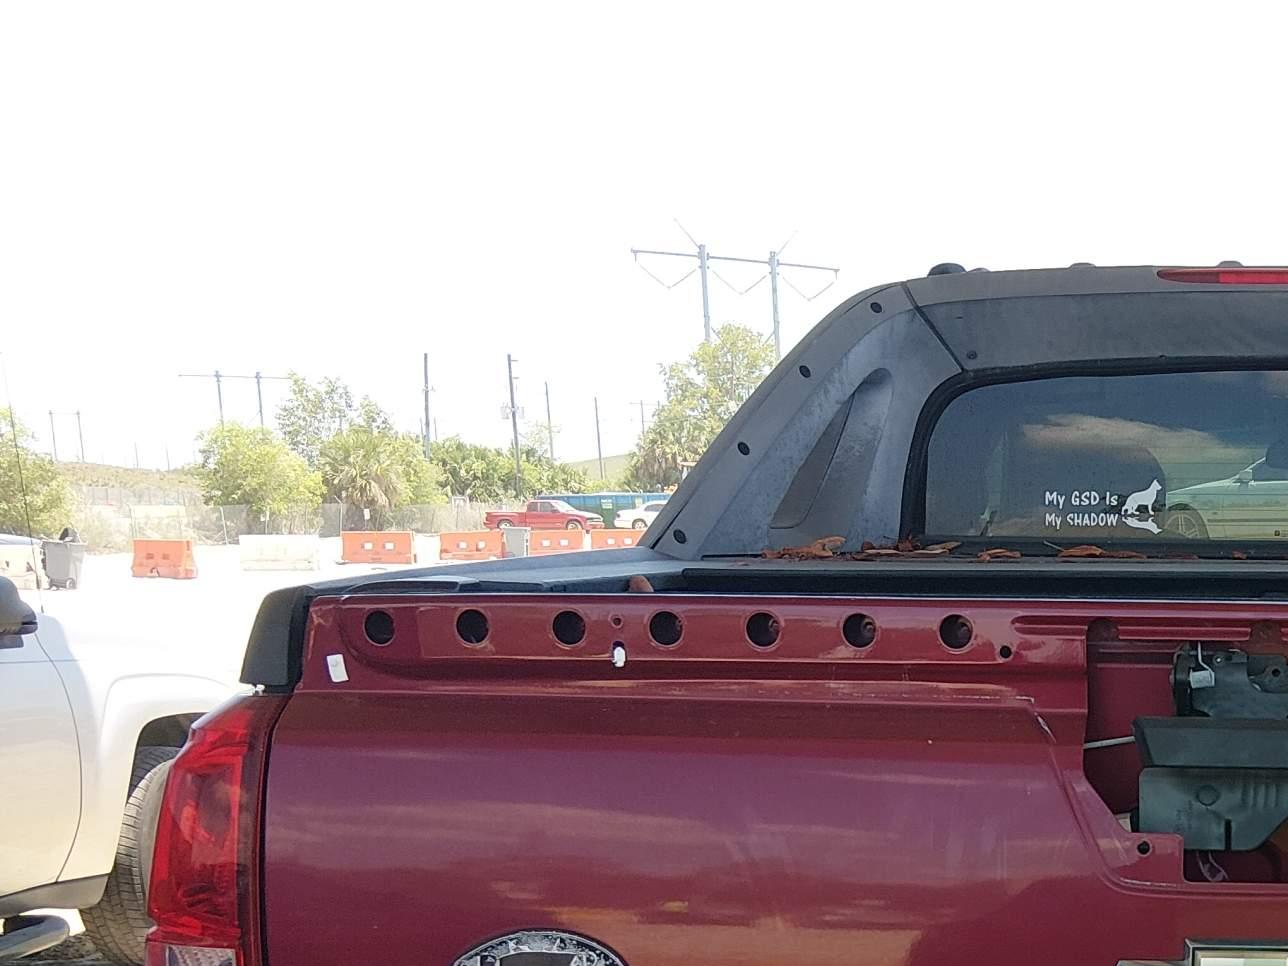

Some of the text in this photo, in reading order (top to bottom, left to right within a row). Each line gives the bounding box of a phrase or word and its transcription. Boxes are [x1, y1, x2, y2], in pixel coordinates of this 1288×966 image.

[1045, 491, 1065, 509] My
[1071, 491, 1100, 506] GSD
[1045, 512, 1119, 530] My SHADOW
